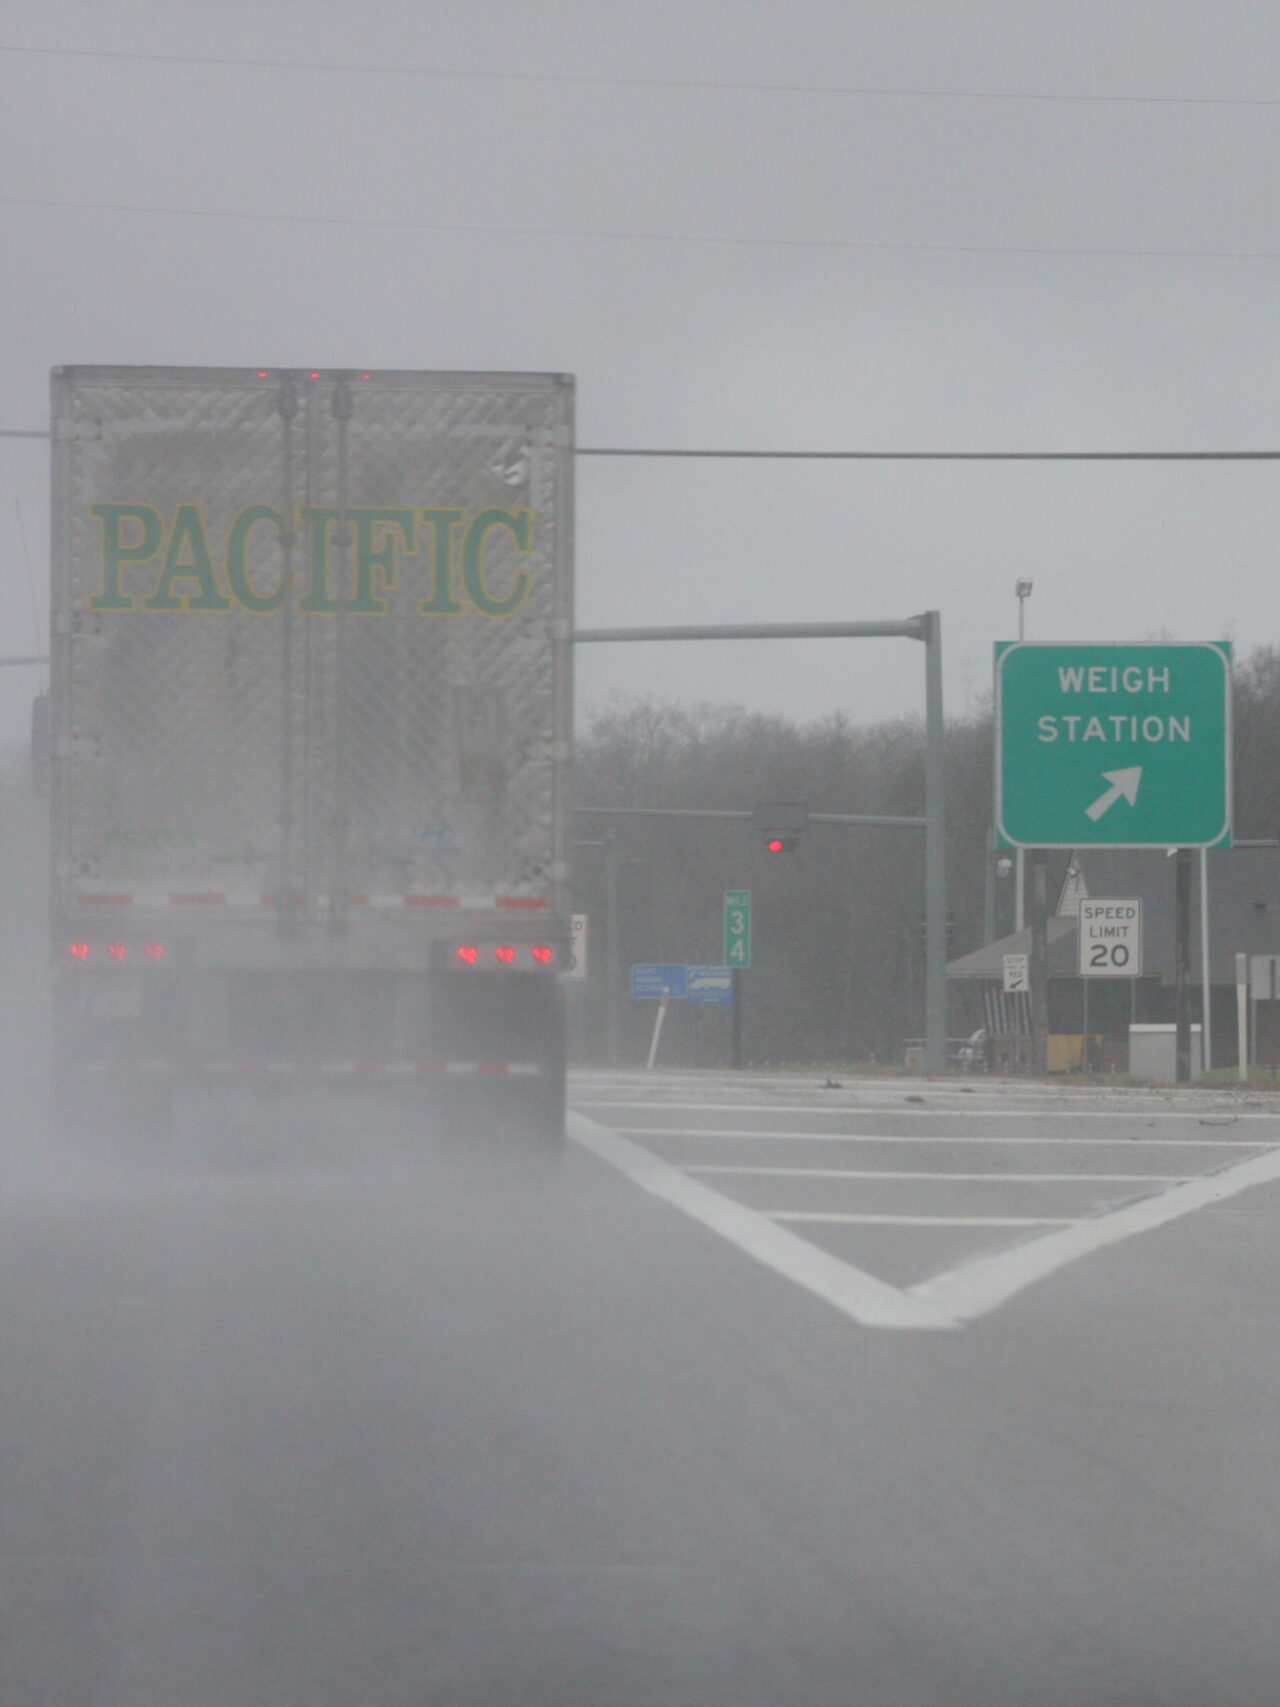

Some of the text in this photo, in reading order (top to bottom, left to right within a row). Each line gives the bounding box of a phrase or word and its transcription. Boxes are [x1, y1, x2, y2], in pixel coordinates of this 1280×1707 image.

[88, 502, 538, 618] PACIFIC
[1058, 665, 1170, 693] WEIGH
[1037, 715, 1191, 742] STATION
[1084, 906, 1136, 919] SPEED
[1089, 925, 1130, 938] LIMIT
[1090, 943, 1130, 967] 20
